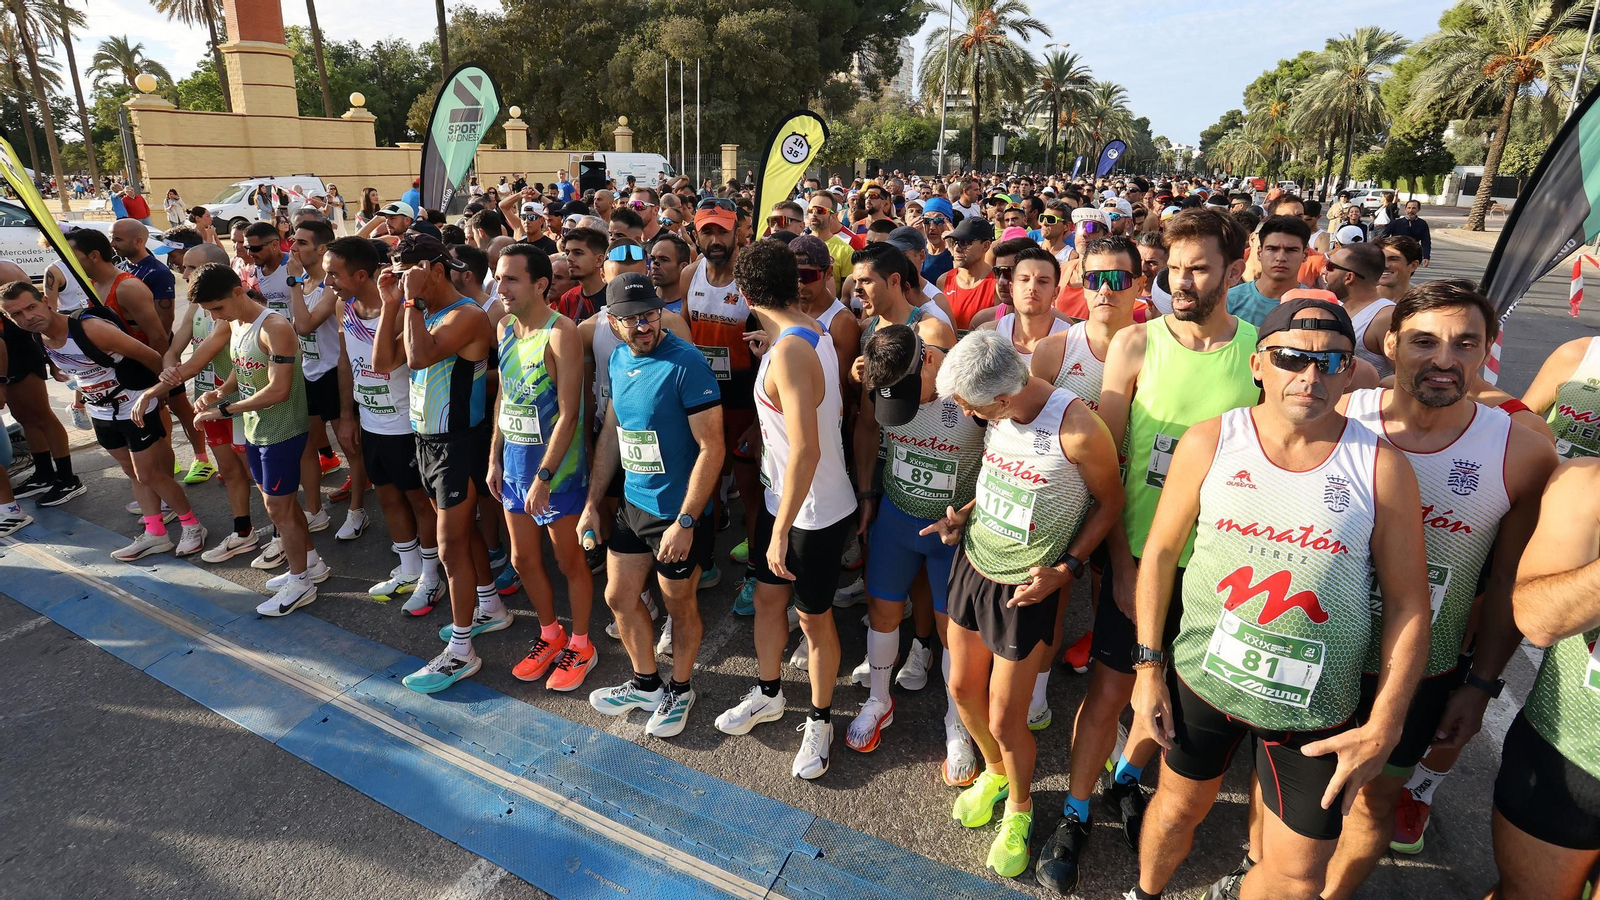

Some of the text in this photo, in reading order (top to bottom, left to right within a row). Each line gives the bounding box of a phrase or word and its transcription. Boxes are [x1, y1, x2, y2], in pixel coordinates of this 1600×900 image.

[448, 123, 481, 135] SPORT
[792, 137, 805, 149] 1h
[503, 376, 538, 396] HYGGE
[363, 395, 378, 406] 84
[508, 417, 523, 432] 20
[886, 431, 961, 453] maratón
[627, 445, 643, 460] 60
[632, 463, 660, 472] MIZUNO
[911, 467, 933, 486] 89
[911, 487, 949, 499] MIZUNO
[1226, 480, 1258, 490] austral
[984, 492, 1015, 521] 117
[984, 517, 1024, 540] MIZUNO
[1214, 517, 1349, 555] maratón
[1247, 545, 1310, 566] JEREZ
[1241, 649, 1280, 679] 81
[1238, 678, 1302, 702] MIZUNO
